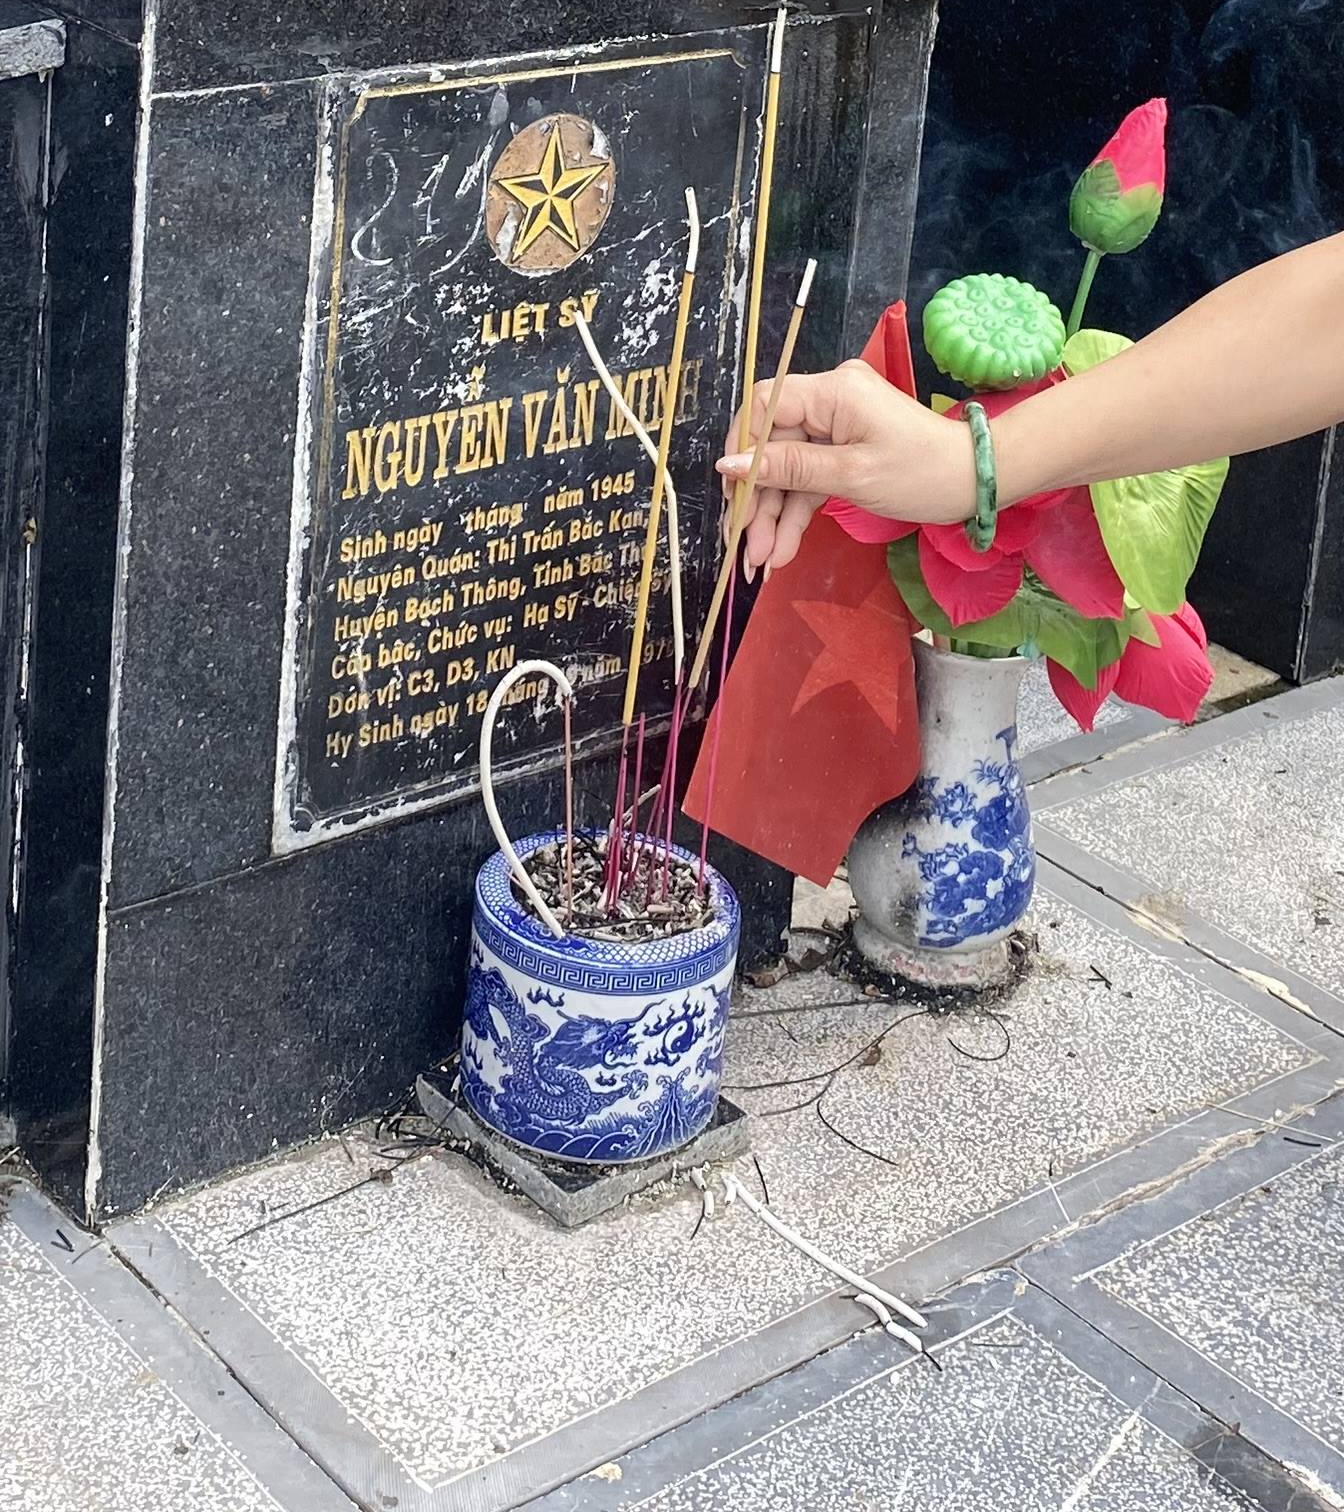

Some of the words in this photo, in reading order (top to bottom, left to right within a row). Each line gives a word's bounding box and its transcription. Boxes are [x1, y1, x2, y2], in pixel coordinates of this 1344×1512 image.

[481, 299, 550, 345] LIỆT
[559, 289, 600, 328] SỸ
[342, 364, 513, 500] NGUYỄN
[522, 365, 601, 459] VĂN
[337, 563, 416, 603] Nguyên
[422, 548, 480, 581] Quán:
[487, 534, 517, 565] Thị
[522, 520, 563, 556] Trấn
[569, 510, 604, 544] Bắc
[340, 529, 387, 563] Sinh
[393, 518, 443, 550] ngày
[465, 502, 524, 535] tháng
[543, 486, 584, 514] năm
[591, 470, 636, 501] 1945
[331, 645, 371, 680] Cấp
[428, 621, 477, 655] Chức
[483, 615, 513, 643] vụ:
[523, 602, 549, 630] Hạ
[554, 589, 579, 622] Sỹ
[335, 607, 398, 642] Huyện
[405, 590, 454, 628] Bạch
[461, 576, 526, 609] Thông,
[533, 558, 574, 588] Tỉnh
[579, 544, 614, 577] Bắc
[377, 679, 401, 709] vị:
[407, 668, 440, 697] C3,
[446, 657, 480, 687] D3,
[486, 644, 515, 674] KN
[325, 731, 355, 759] Hy
[358, 714, 404, 748] Sinh
[410, 699, 460, 738] ngày
[466, 690, 490, 716] 18
